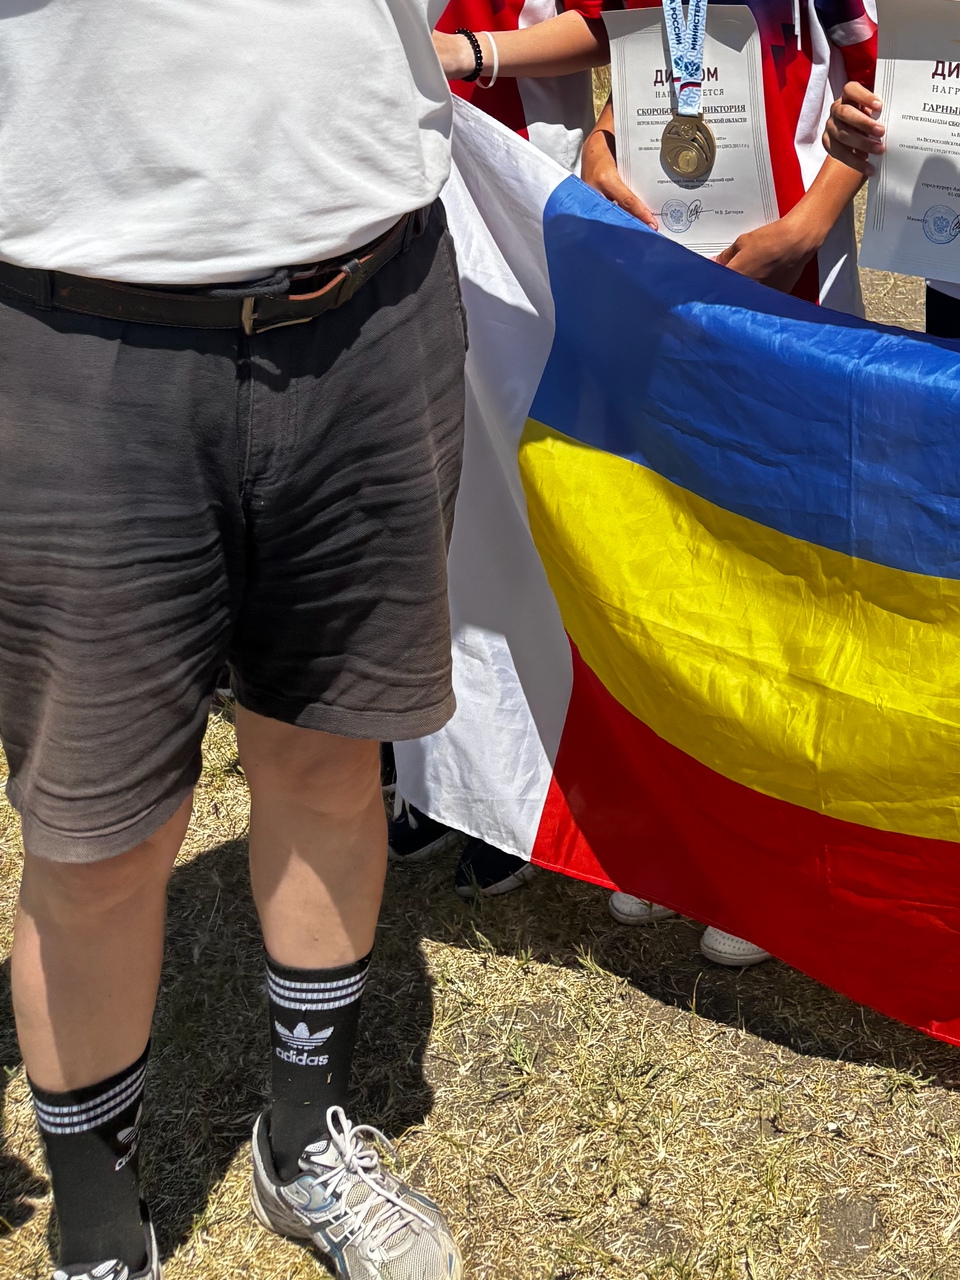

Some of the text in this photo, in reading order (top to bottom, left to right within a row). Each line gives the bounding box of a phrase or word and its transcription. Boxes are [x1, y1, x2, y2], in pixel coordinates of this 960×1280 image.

[671, 7, 683, 46] РОССИИ
[702, 104, 746, 115] ВИКТОРИЯ
[276, 1047, 329, 1065] adidas
